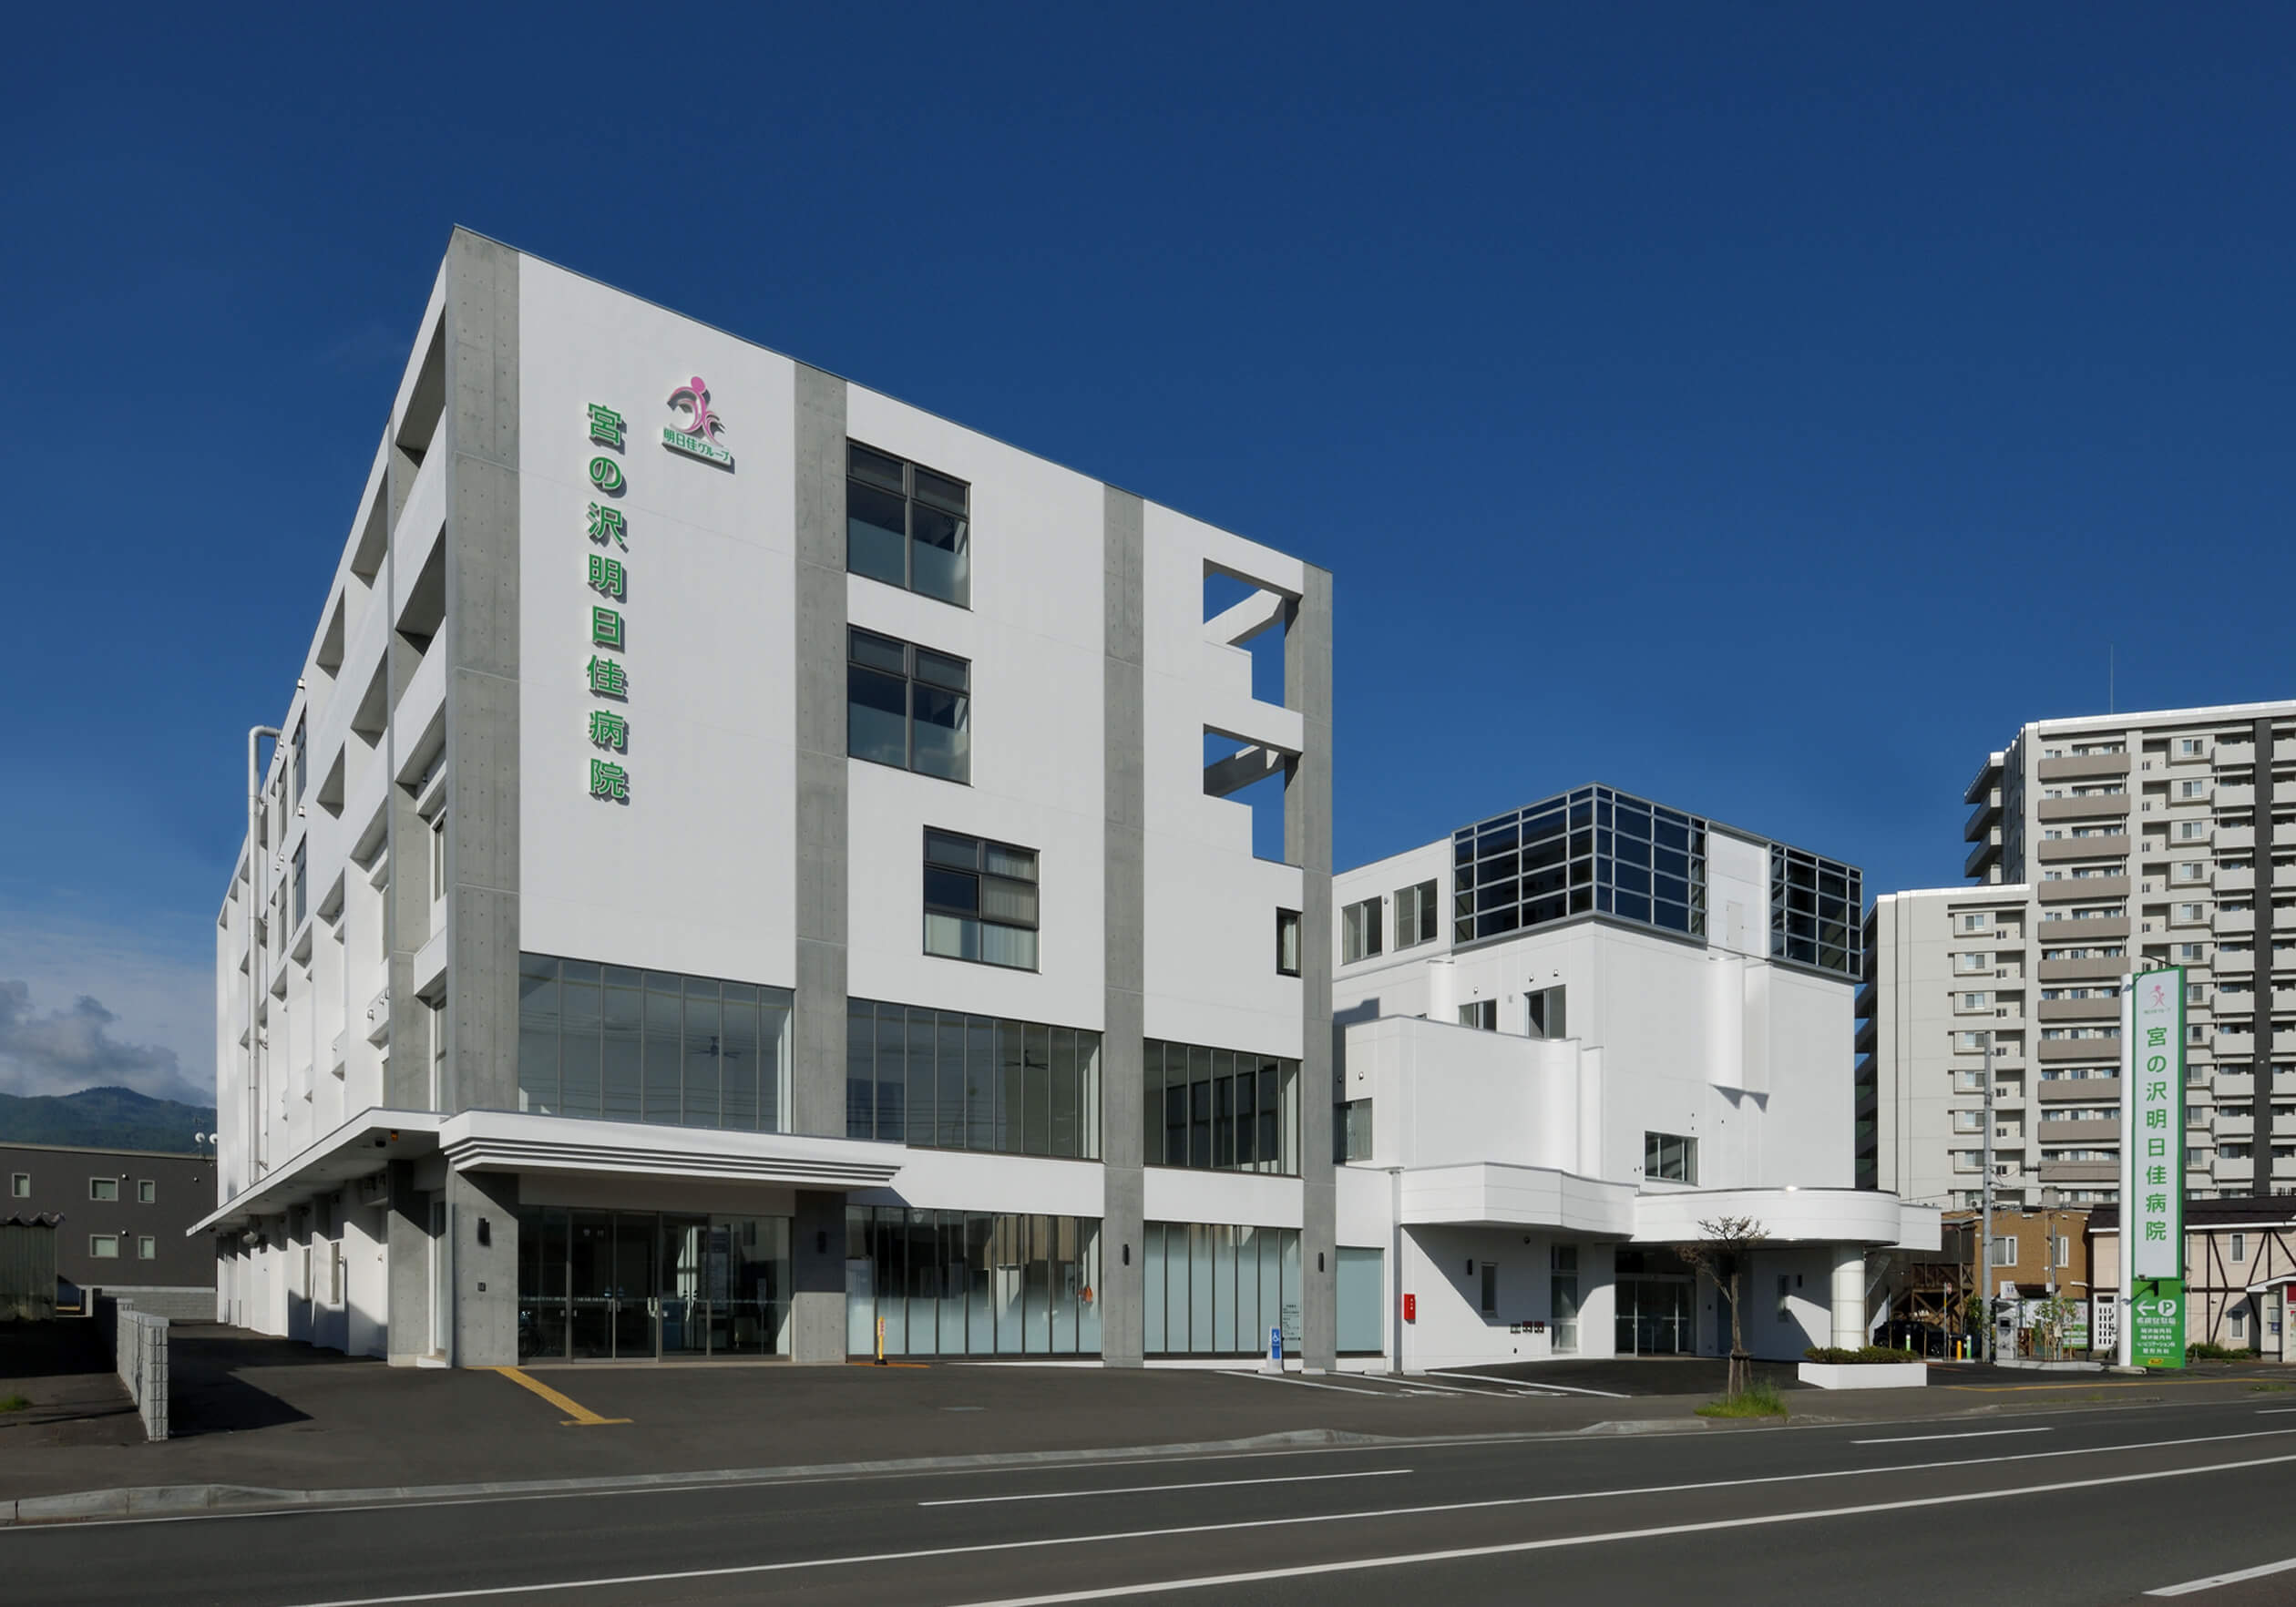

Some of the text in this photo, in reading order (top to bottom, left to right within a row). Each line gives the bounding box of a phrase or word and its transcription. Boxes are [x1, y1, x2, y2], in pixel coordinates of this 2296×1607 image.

[587, 403, 626, 798] 宮の沢明日佳病院
[2146, 1027, 2168, 1242] 宮の沢明日佳病院
